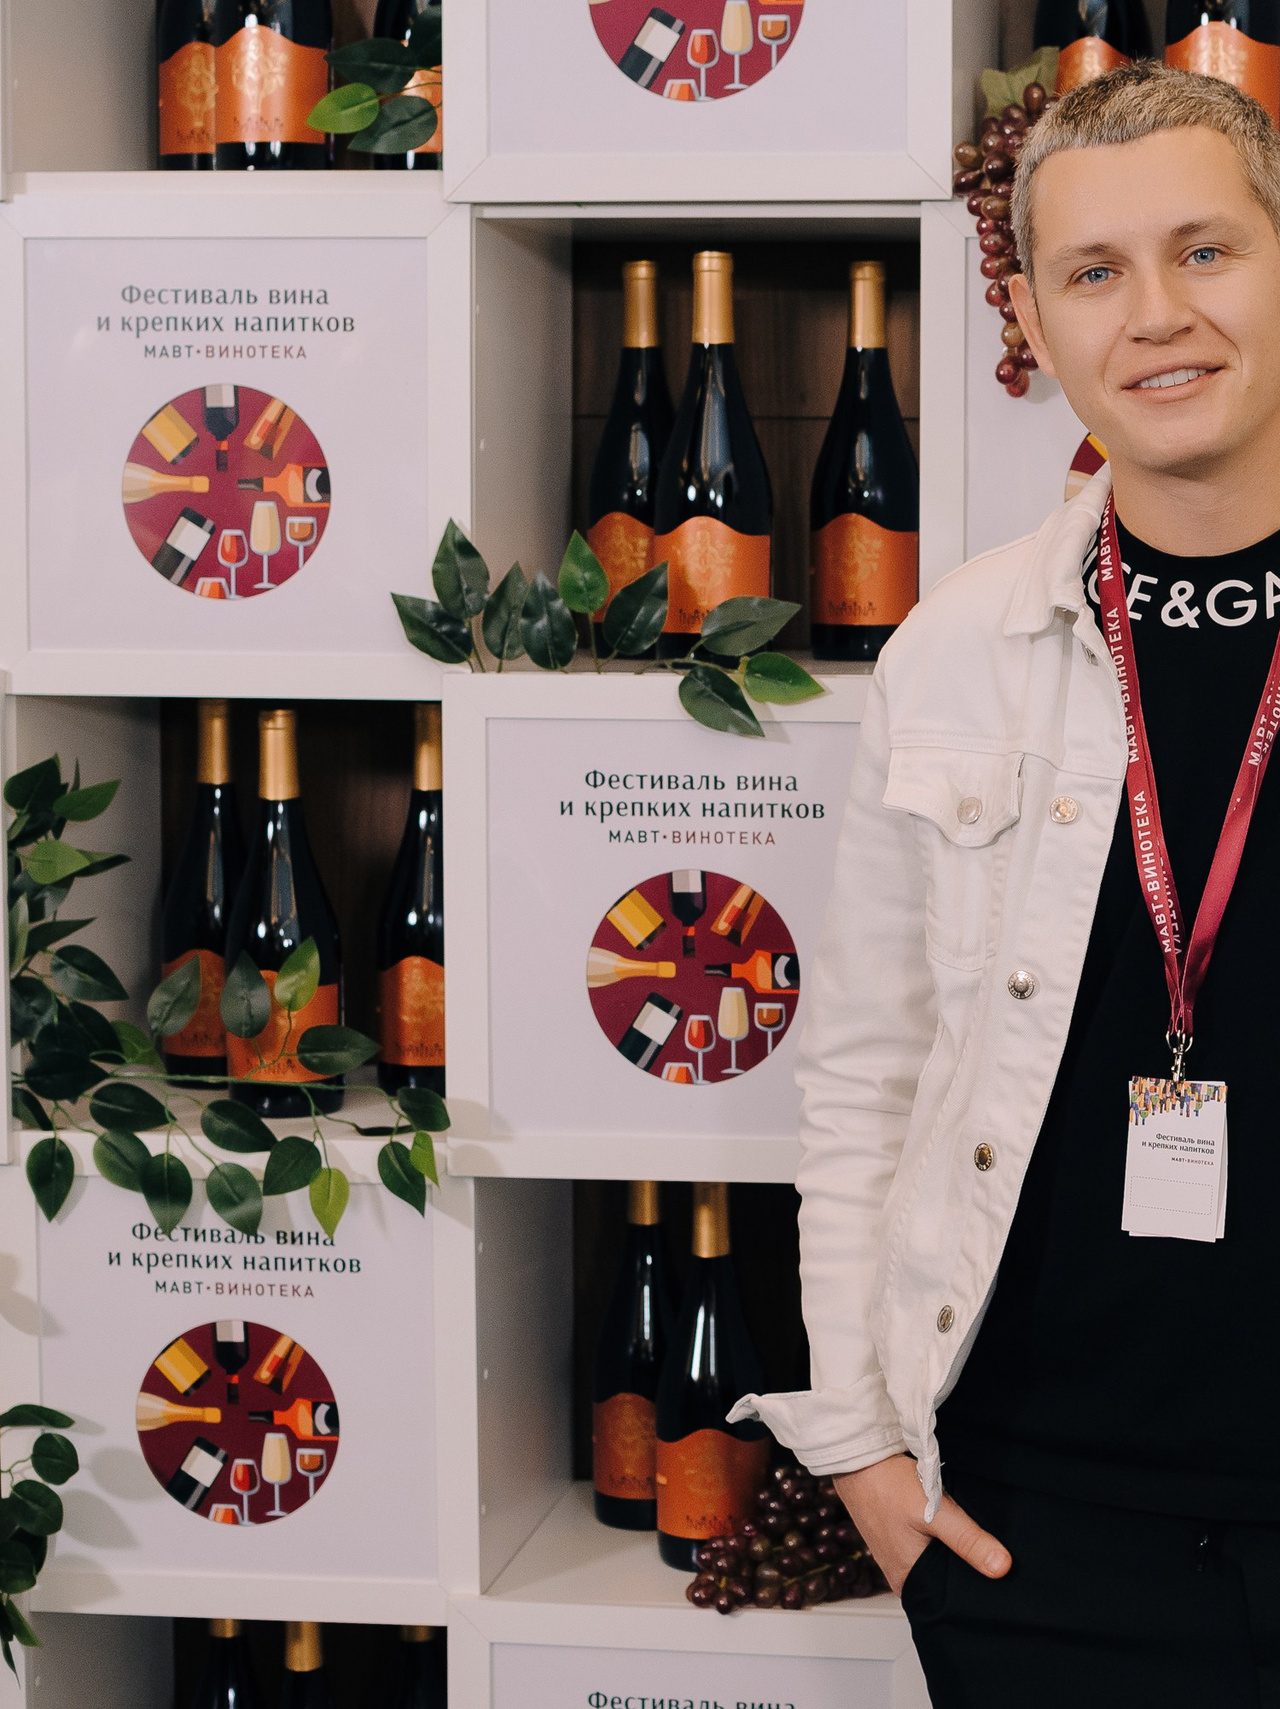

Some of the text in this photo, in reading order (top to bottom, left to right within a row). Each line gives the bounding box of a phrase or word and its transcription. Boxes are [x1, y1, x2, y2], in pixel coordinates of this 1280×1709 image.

[121, 285, 329, 305] Фестиваль вина
[96, 315, 355, 339] и крепких напитков
[584, 770, 799, 792] Фестиваль вина
[560, 800, 825, 824] и крепких напитков
[1148, 1141, 1178, 1150] крепких
[1179, 1145, 1215, 1155] напитков
[1155, 1132, 1215, 1147] Фестиваль вина
[276, 1229, 336, 1247] вина
[108, 1251, 362, 1274] и крепких напитков
